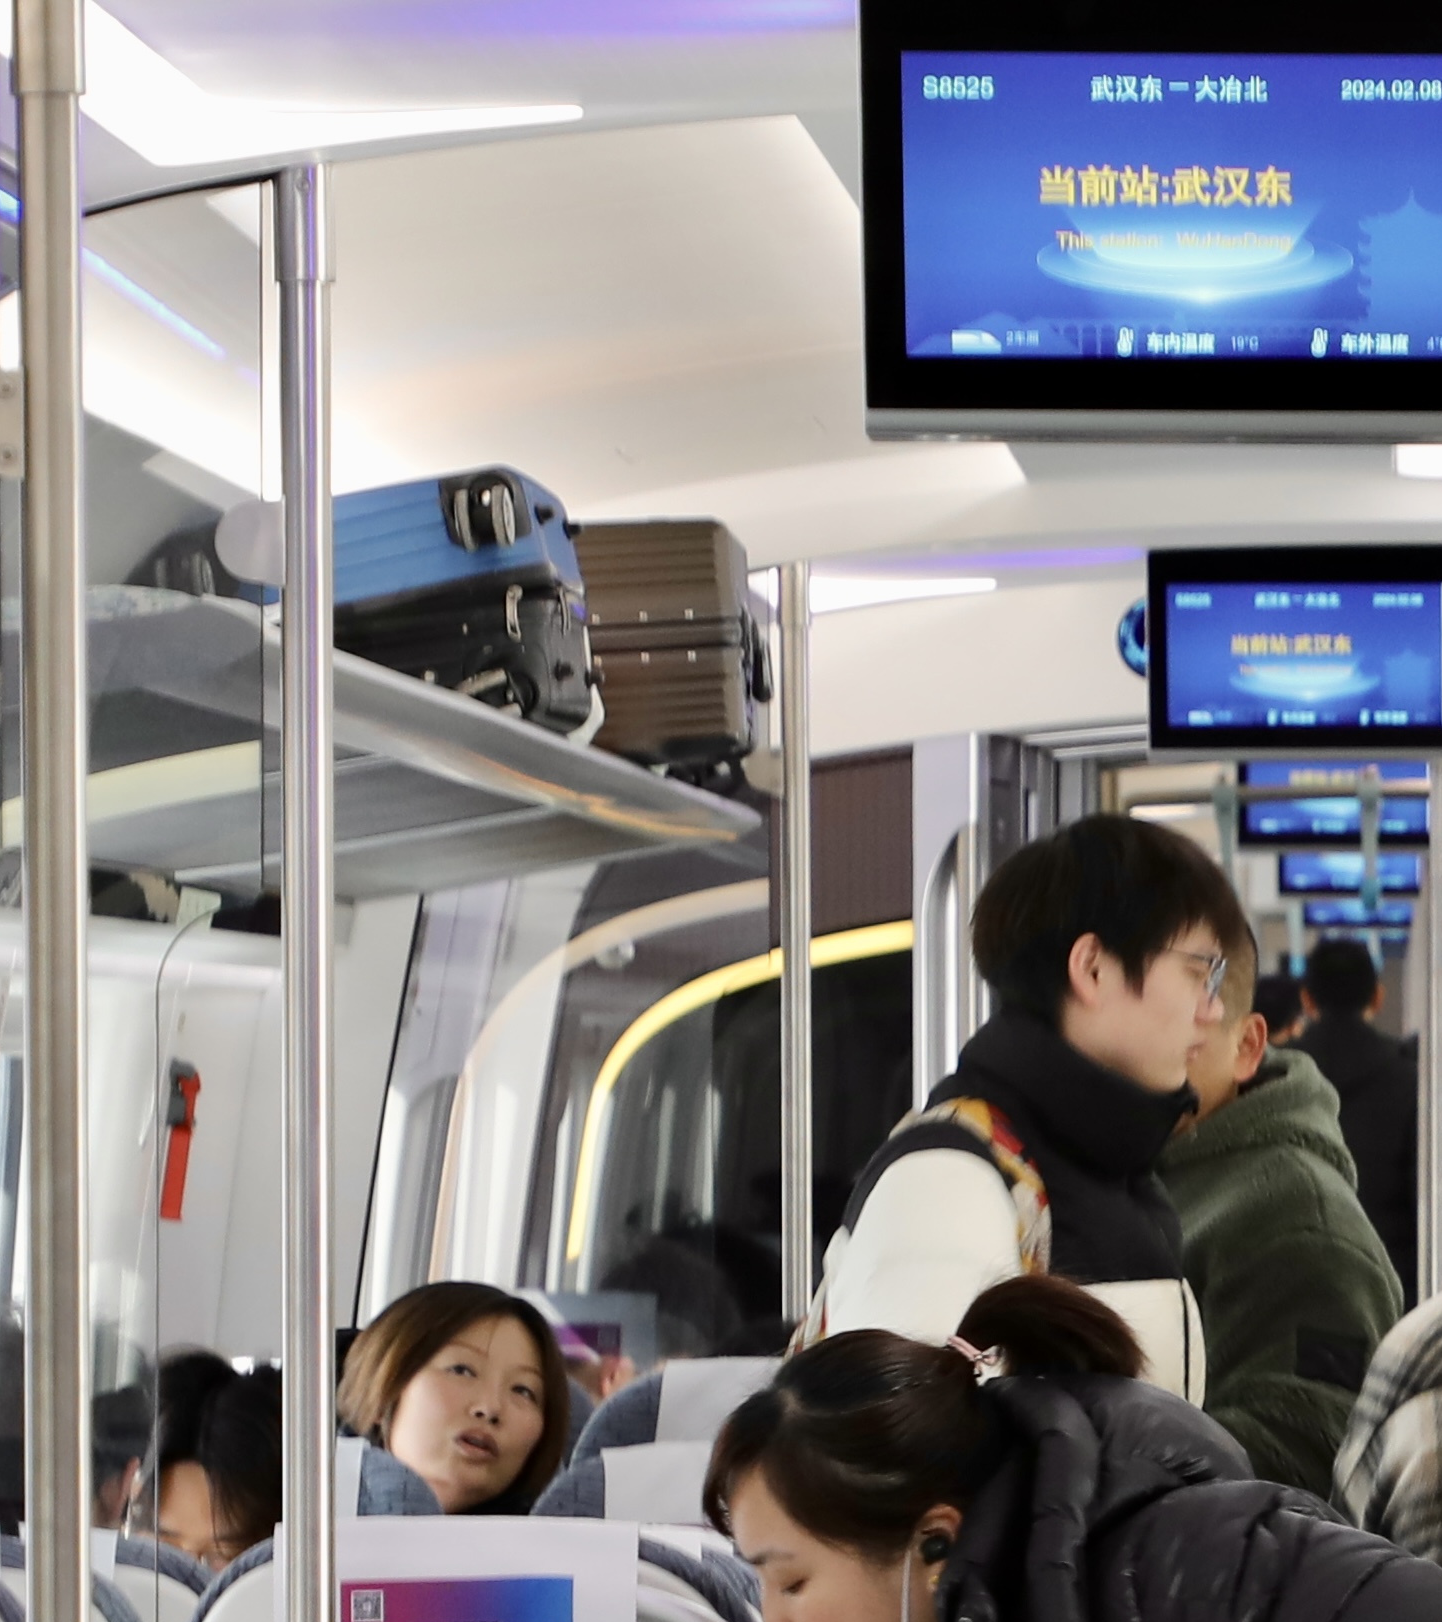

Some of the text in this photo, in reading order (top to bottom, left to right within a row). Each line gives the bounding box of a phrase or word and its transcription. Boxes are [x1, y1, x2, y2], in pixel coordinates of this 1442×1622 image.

[922, 75, 995, 101] S8525
[1038, 164, 1294, 207] 当前站:武汉东
[1055, 229, 1094, 250] This
[1146, 331, 1216, 355] 车内温度
[1340, 332, 1410, 356] 车外温度
